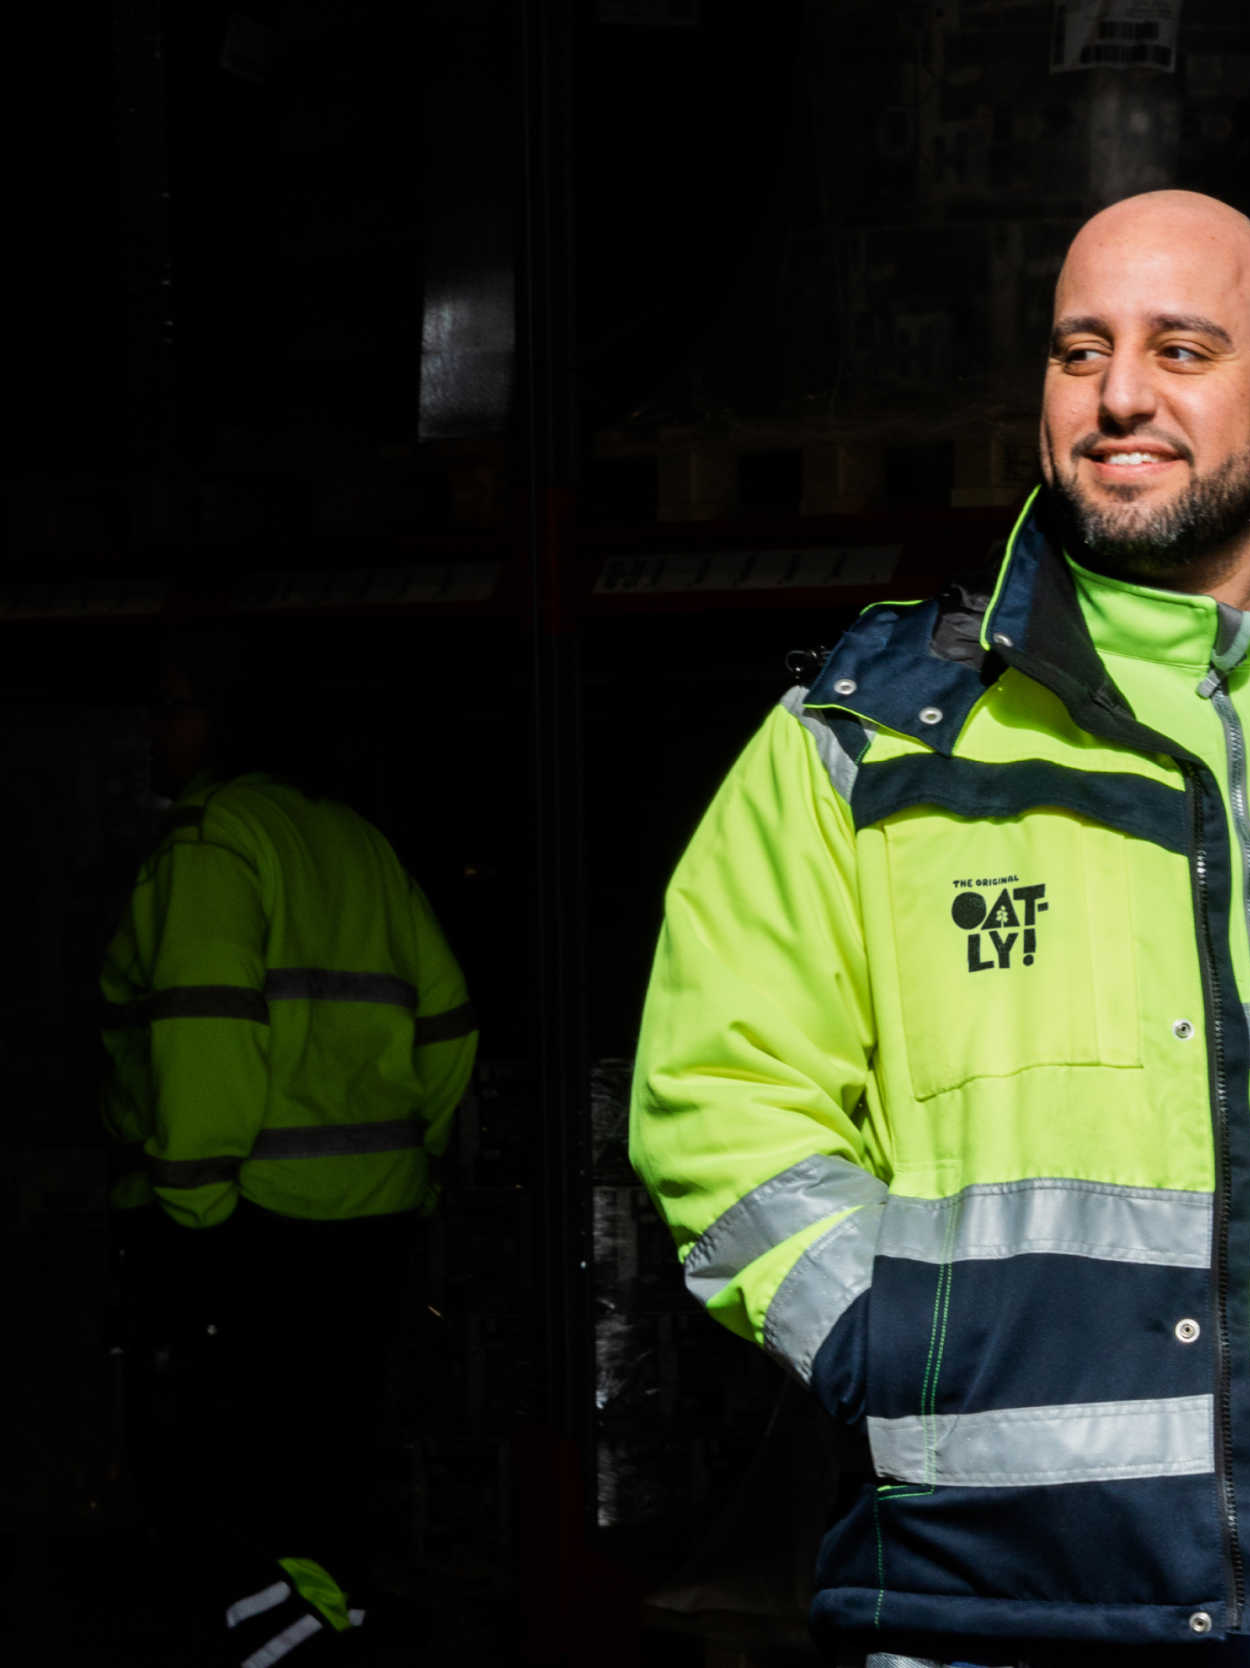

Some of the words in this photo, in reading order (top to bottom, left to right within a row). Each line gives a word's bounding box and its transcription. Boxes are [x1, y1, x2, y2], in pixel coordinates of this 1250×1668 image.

[952, 879, 973, 888] THE
[975, 875, 1019, 887] ORIGINAL
[968, 928, 1036, 972] LY!
